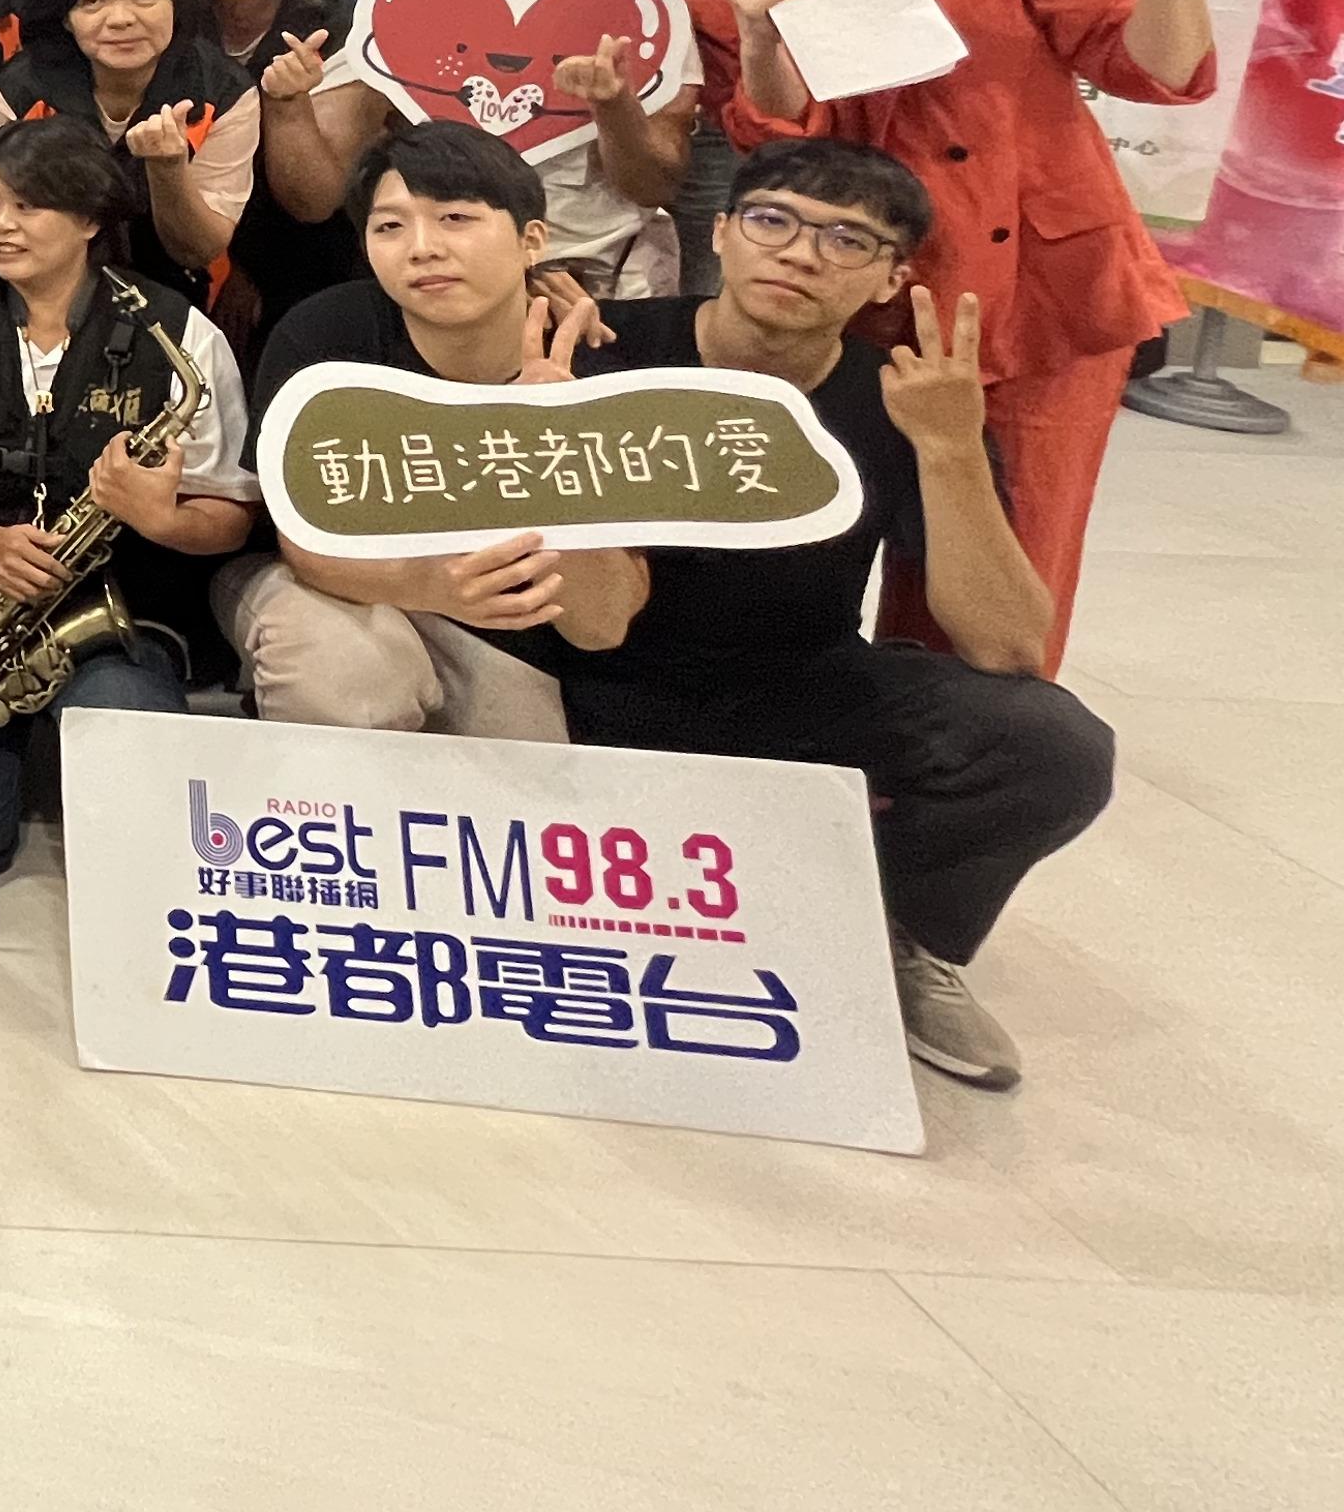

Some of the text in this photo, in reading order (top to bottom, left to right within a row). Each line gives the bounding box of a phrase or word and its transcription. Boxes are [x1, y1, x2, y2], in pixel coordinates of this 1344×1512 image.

[312, 417, 780, 506] 動員港都的愛
[188, 778, 741, 923] best FM 98.3
[266, 797, 337, 819] RADIO
[197, 865, 380, 910] 好事聯播網
[162, 908, 801, 1064] 港都電台
